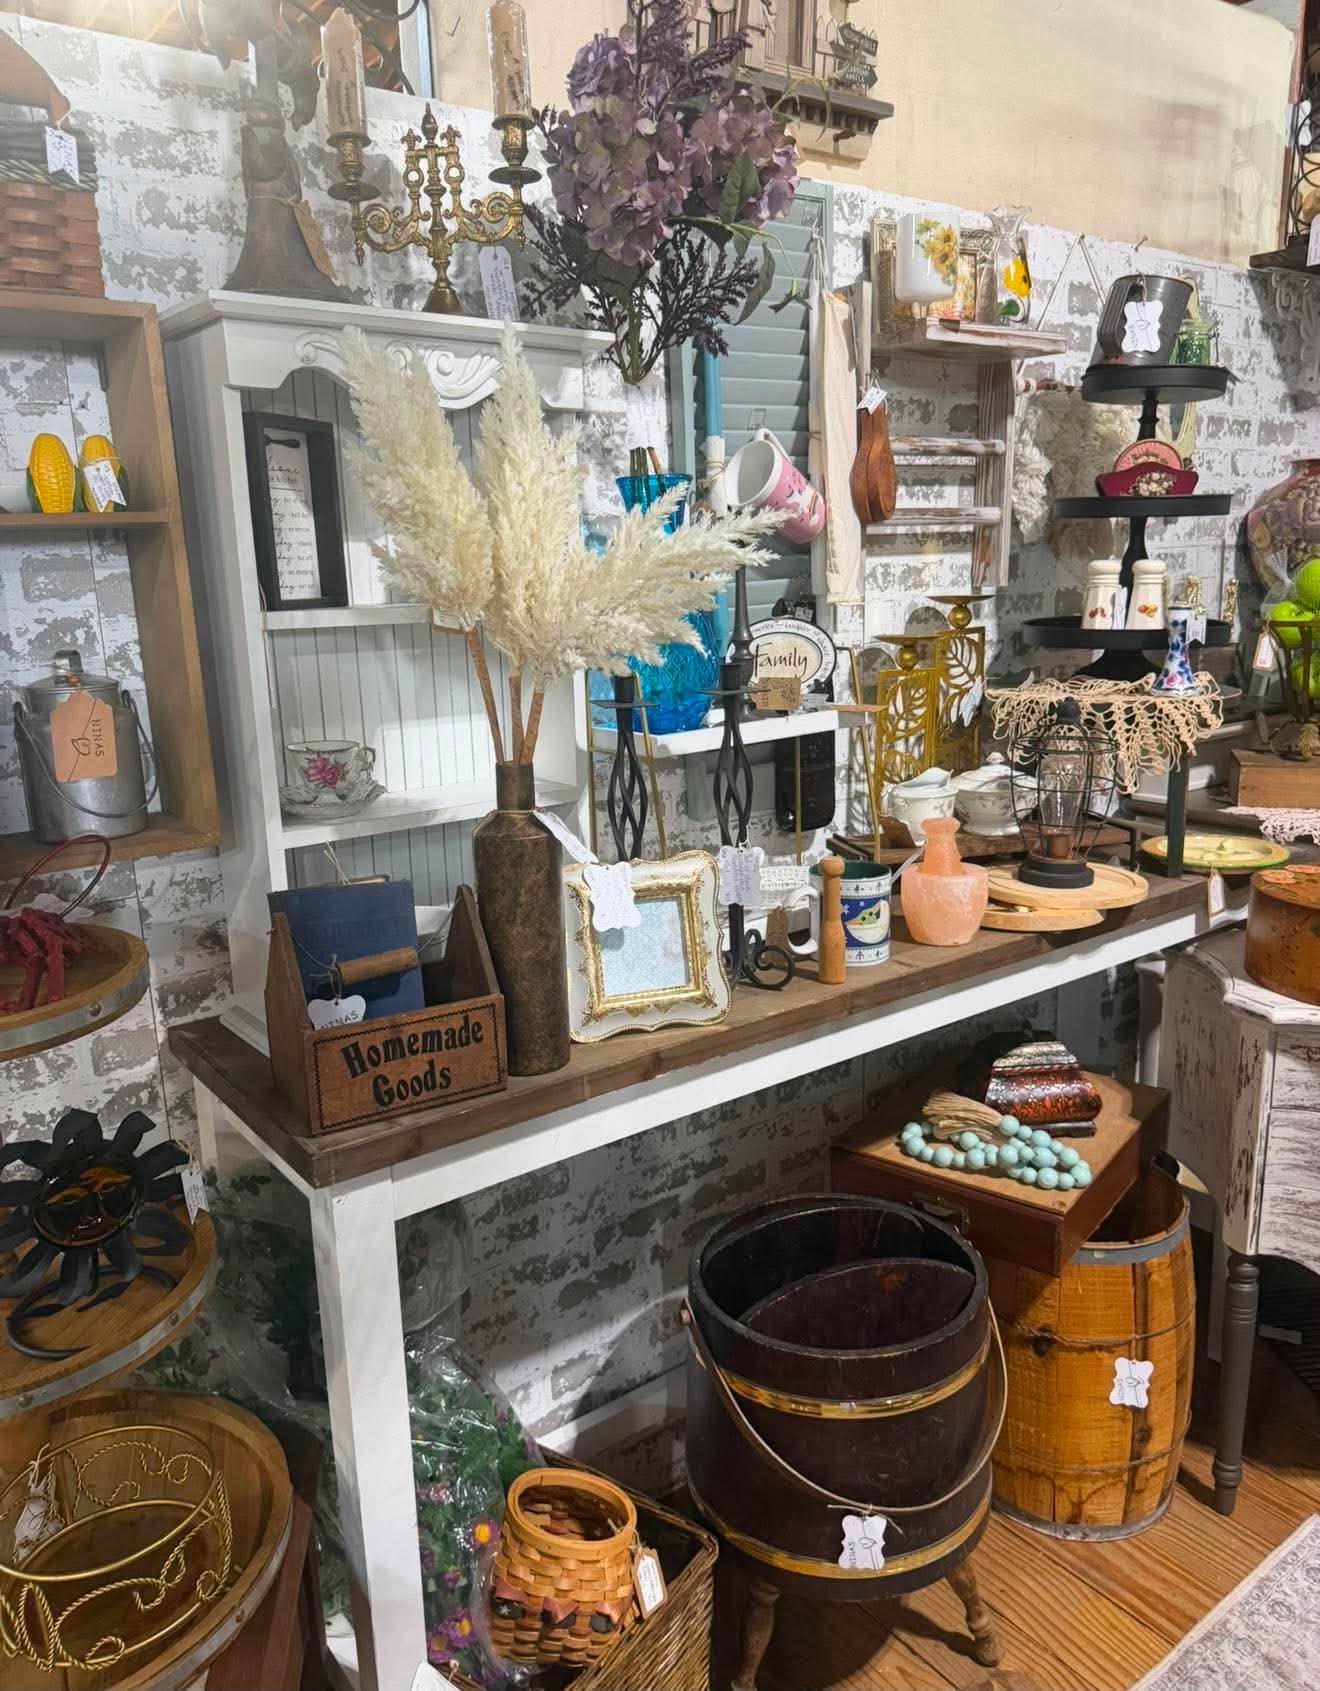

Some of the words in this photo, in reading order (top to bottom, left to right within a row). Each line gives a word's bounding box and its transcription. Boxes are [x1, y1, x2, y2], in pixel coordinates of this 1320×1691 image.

[753, 642, 808, 679] Family
[341, 1014, 483, 1079] Homemade
[372, 1059, 452, 1107] Goods
